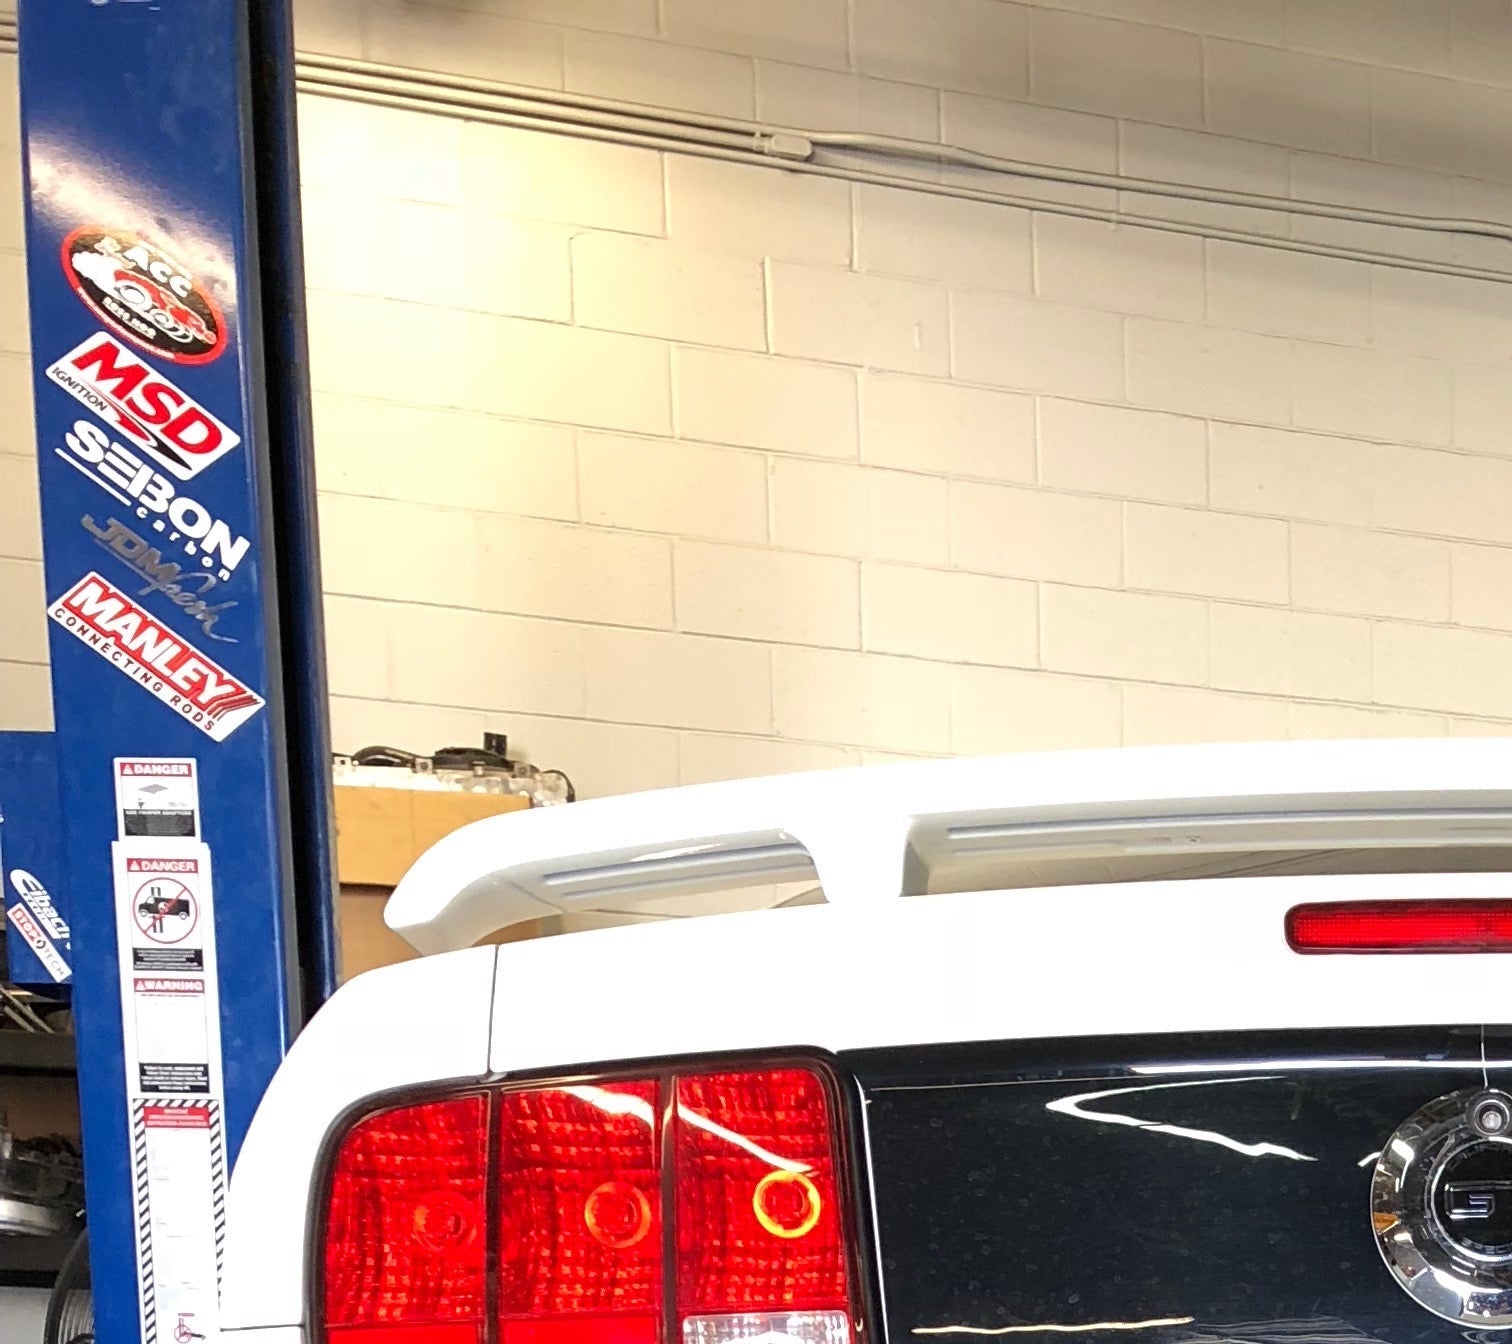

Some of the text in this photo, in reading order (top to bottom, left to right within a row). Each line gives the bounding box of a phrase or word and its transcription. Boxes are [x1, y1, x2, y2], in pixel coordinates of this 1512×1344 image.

[52, 367, 108, 411] IGNITION
[71, 341, 222, 454] MSD
[136, 506, 230, 582] carbon
[54, 608, 215, 731] CONNECTING RODS
[68, 580, 238, 704] MANLEY
[133, 764, 189, 776] DANGER
[141, 860, 195, 872] DANGER
[144, 979, 203, 992] WARNING
